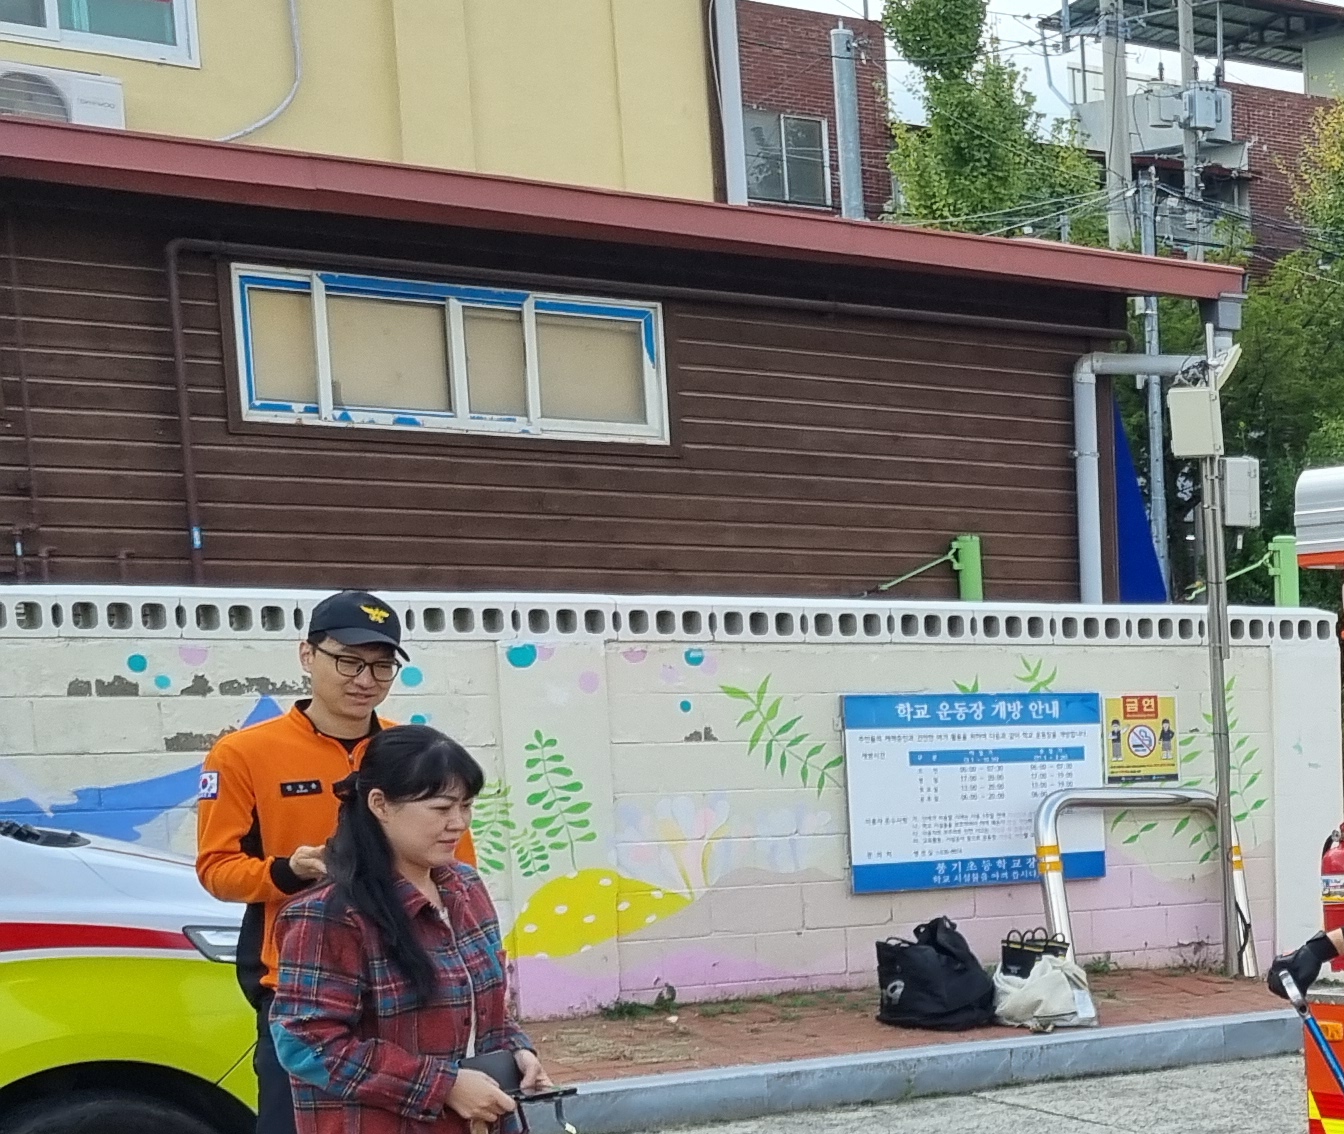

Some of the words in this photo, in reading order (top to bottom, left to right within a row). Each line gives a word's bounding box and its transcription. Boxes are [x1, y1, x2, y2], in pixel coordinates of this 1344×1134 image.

[894, 702, 931, 722] 학교
[935, 701, 985, 721] 운동장
[991, 700, 1024, 721] 개방
[1028, 700, 1060, 720] 안내
